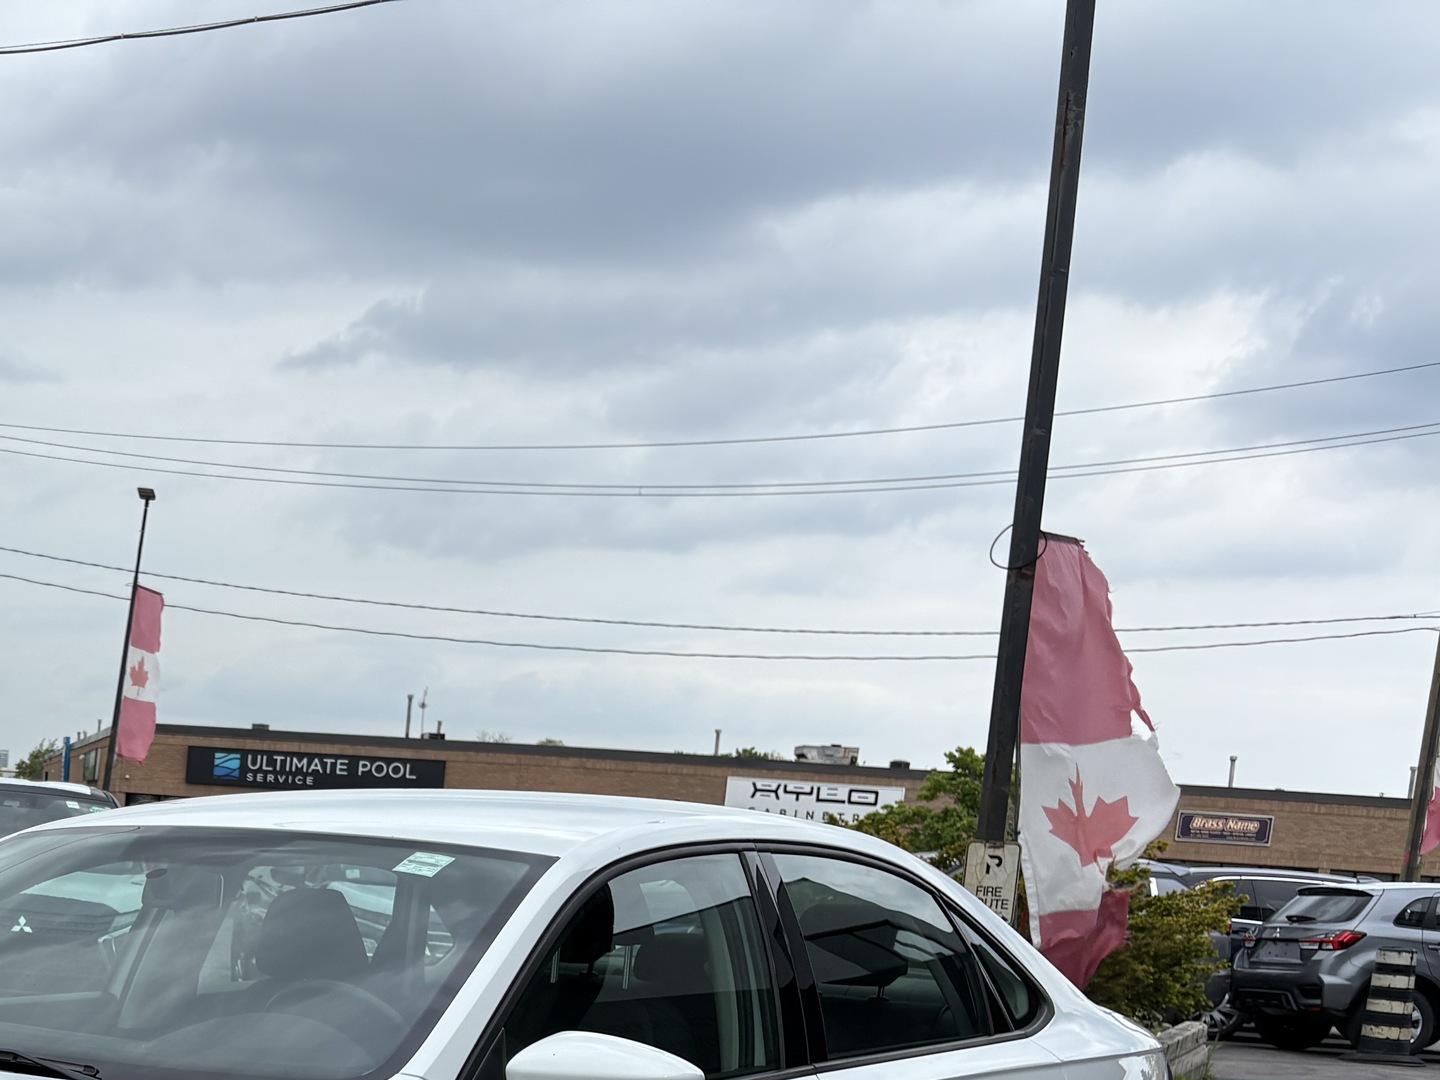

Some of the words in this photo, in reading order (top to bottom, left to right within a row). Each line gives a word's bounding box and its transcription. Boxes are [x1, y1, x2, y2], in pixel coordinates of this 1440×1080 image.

[247, 754, 348, 775] ULTIMATE
[358, 761, 417, 780] POOL
[246, 772, 314, 786] SERVICE
[750, 781, 879, 806] XYLO
[1192, 816, 1224, 829] Brass
[1226, 818, 1258, 831] Name
[976, 885, 1003, 897] FIRE
